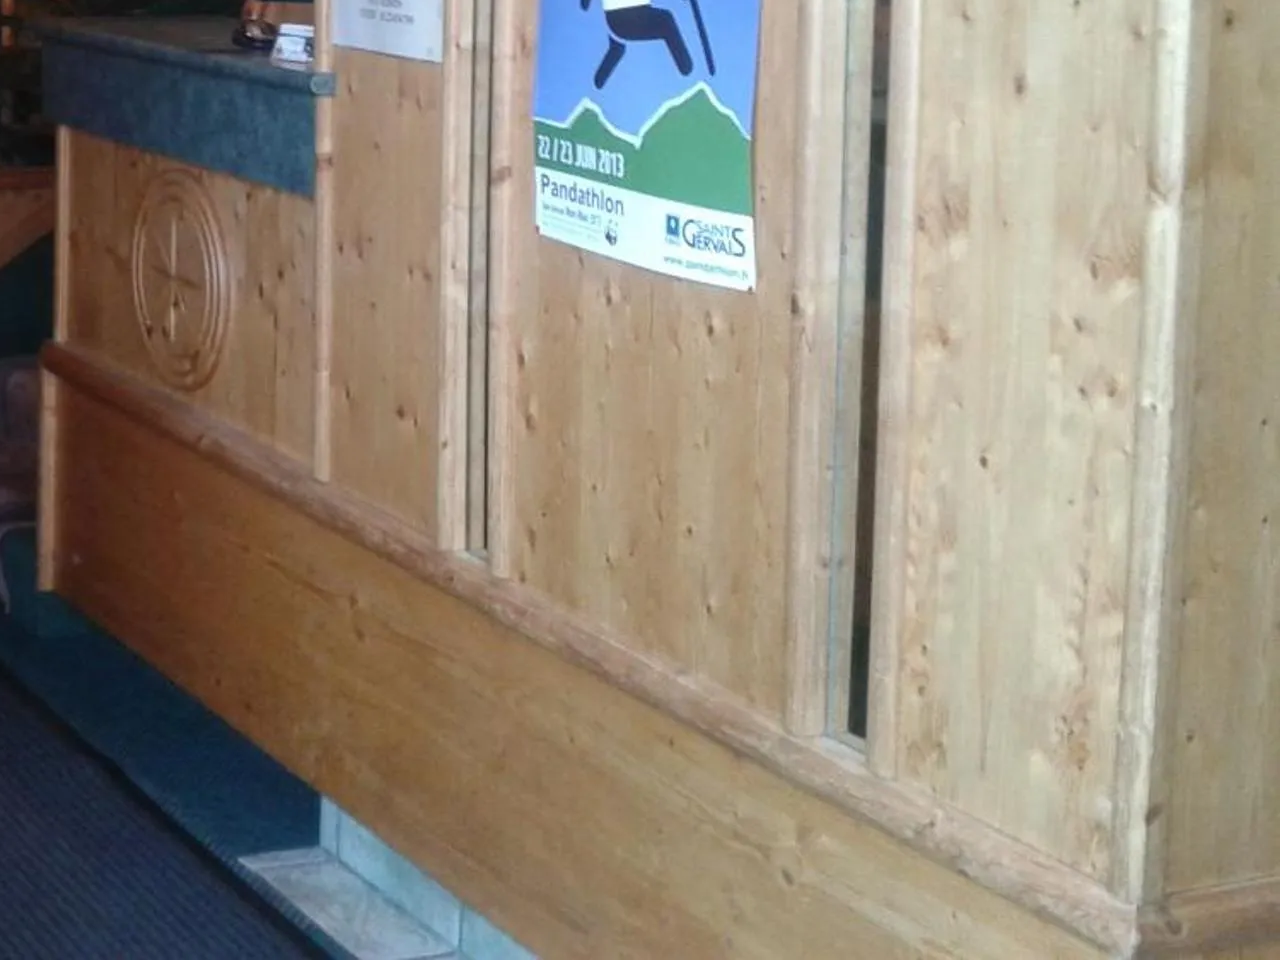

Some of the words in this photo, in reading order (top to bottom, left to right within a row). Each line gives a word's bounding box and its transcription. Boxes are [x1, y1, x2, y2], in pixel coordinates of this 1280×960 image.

[537, 133, 551, 160] 22
[559, 139, 574, 165] 23
[574, 143, 597, 171] JUIN
[598, 148, 625, 179] 2013
[540, 172, 625, 217] Pandathlon
